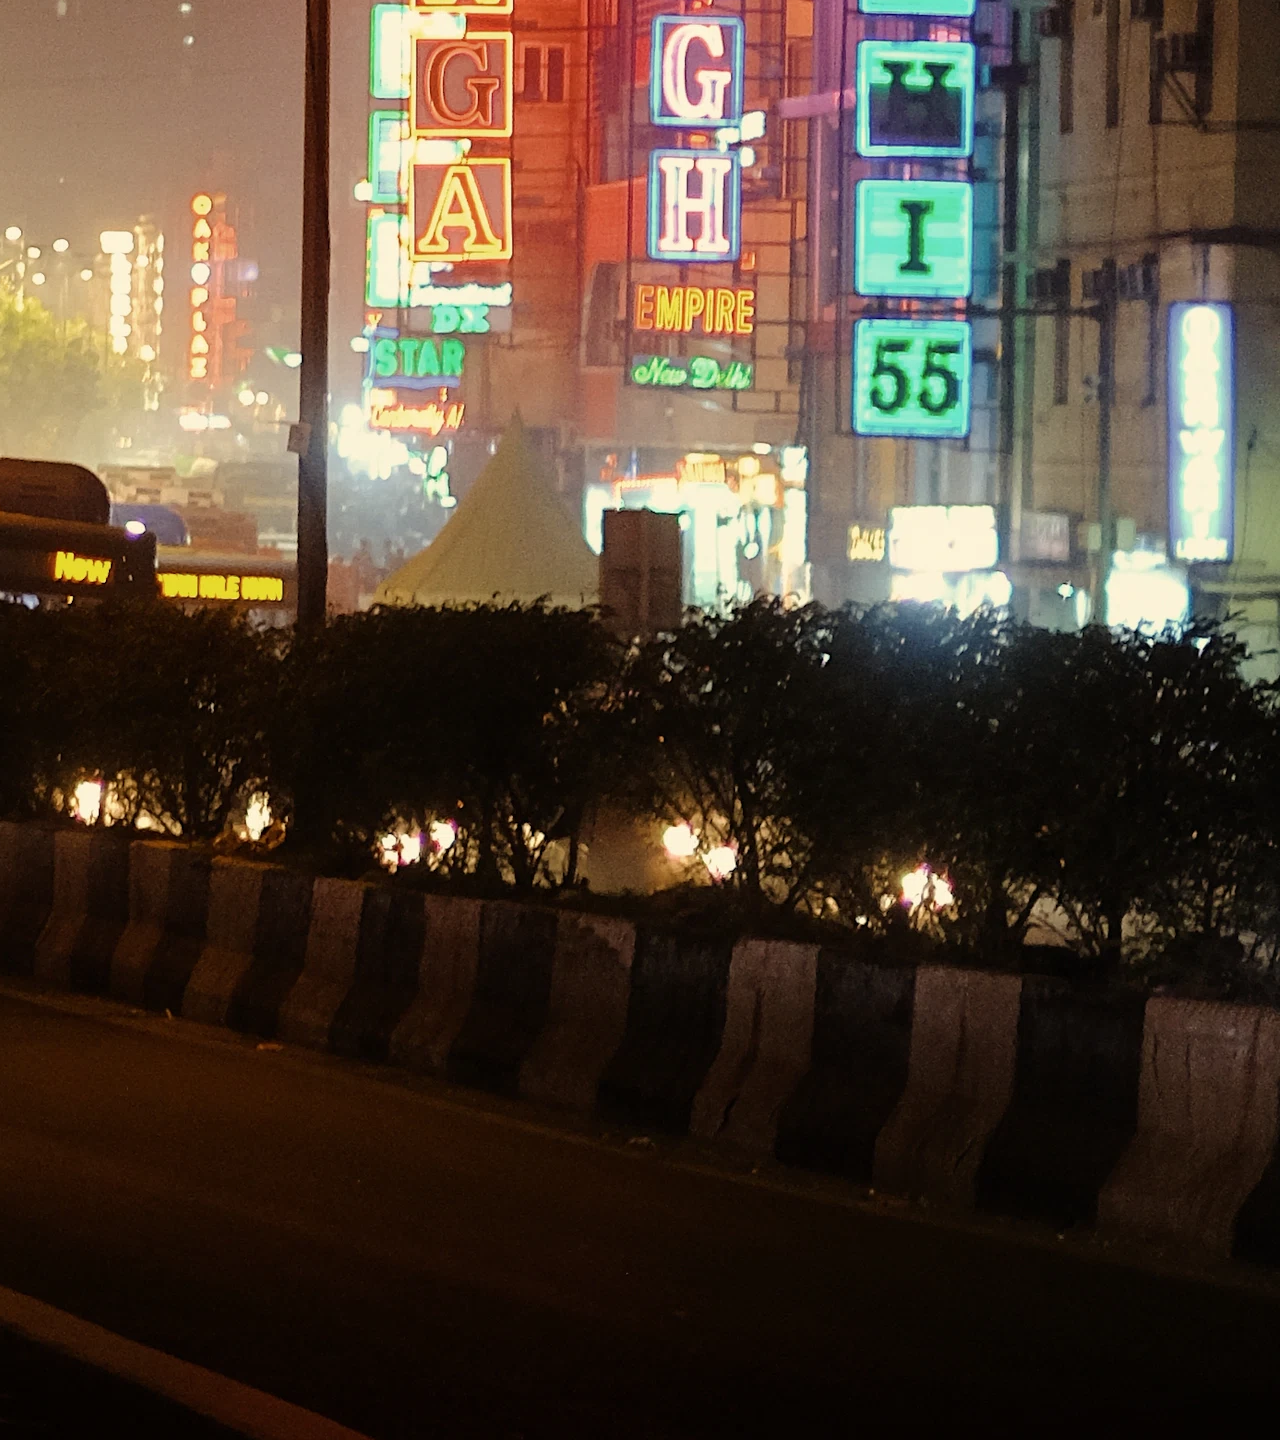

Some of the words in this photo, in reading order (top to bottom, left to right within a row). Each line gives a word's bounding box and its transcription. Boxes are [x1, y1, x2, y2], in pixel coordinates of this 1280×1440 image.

[430, 303, 491, 334] DX
[637, 283, 756, 334] EMPIRE
[376, 337, 466, 378] STAR
[633, 355, 688, 386] New
[689, 355, 753, 390] Delhi
[868, 338, 961, 416] 55
